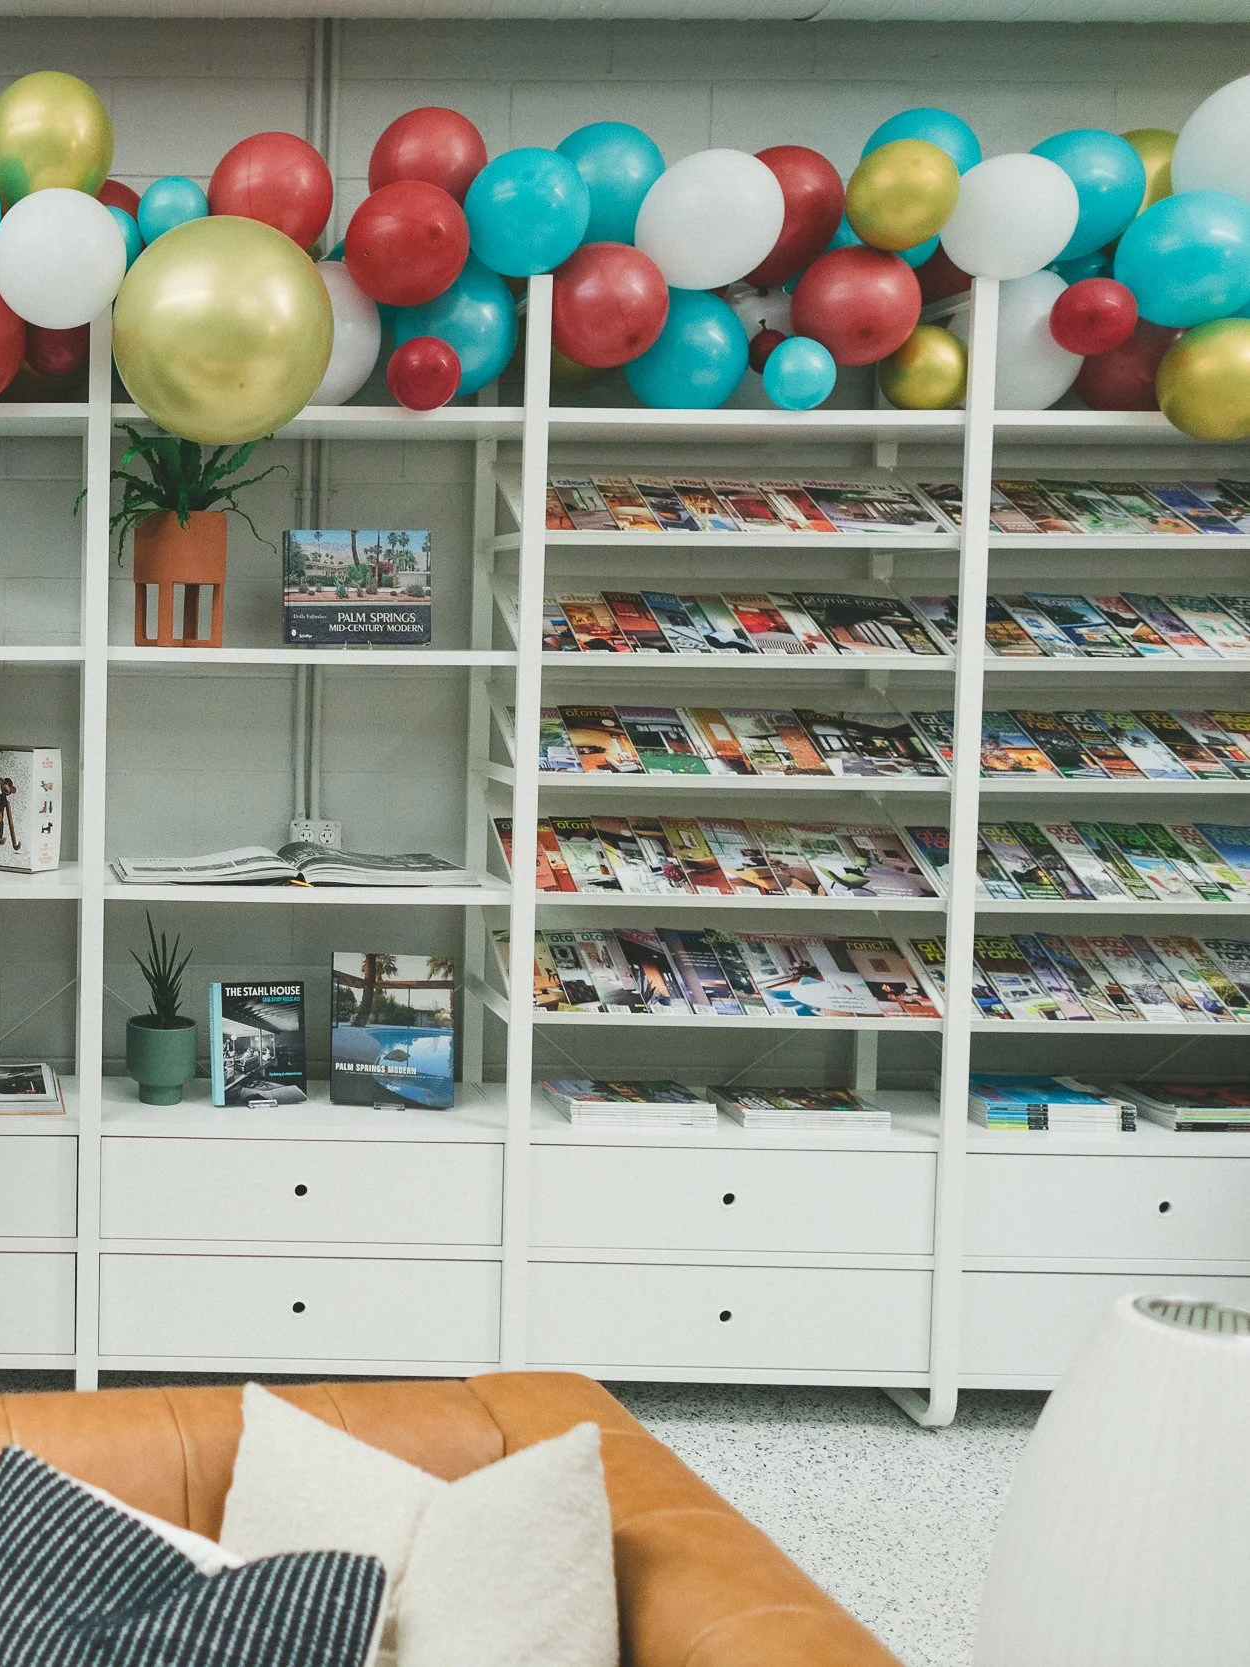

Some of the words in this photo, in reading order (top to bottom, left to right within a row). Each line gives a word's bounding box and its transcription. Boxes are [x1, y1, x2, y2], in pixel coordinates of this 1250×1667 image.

[337, 612, 366, 623] PALM
[370, 612, 417, 623] SPRINGS
[329, 624, 384, 632] MID-CENTURY
[387, 624, 424, 632] MODERN
[565, 709, 615, 718] atomic
[556, 821, 592, 830] atom
[846, 941, 890, 951] ranch
[979, 949, 1024, 960] ranc
[225, 987, 242, 997] THE
[243, 986, 269, 997] STAHL
[270, 985, 301, 996] HOUSE
[335, 1062, 354, 1071] PALM
[356, 1063, 386, 1073] SPRINGS
[388, 1065, 417, 1075] MODERN
